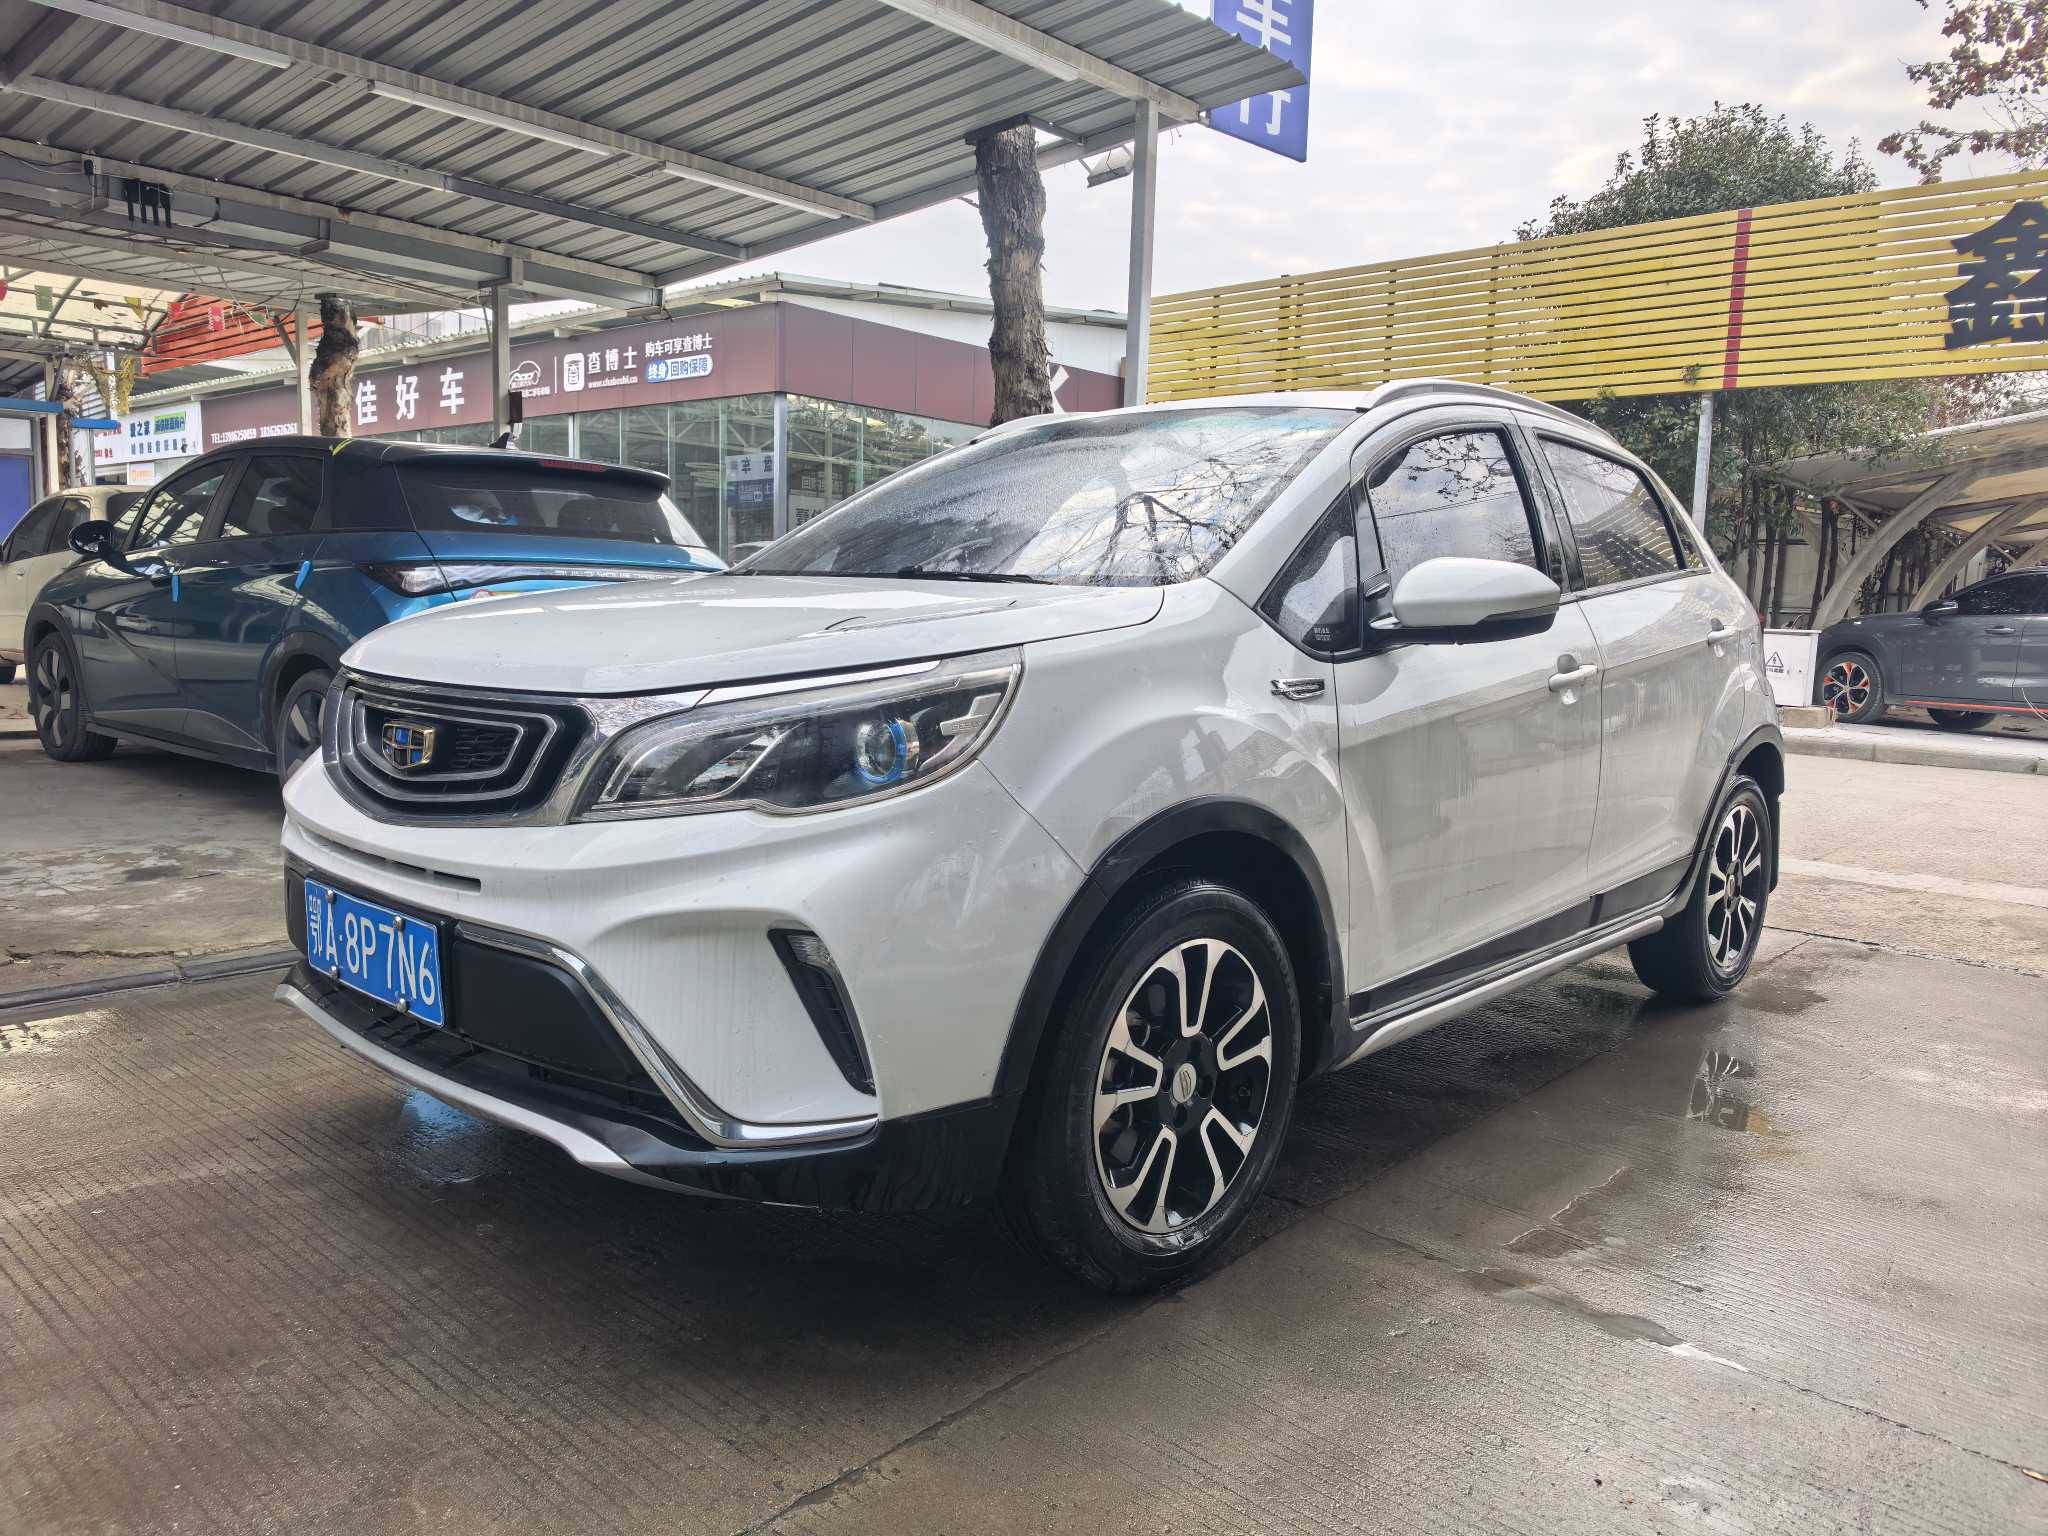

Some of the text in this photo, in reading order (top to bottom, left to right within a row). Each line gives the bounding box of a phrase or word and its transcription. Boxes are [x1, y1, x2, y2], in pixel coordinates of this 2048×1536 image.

[644, 332, 712, 358] 购车可享查博士
[587, 346, 638, 375] 查博士
[648, 357, 708, 380] 终身 回购保障
[355, 367, 465, 426] 佳好车
